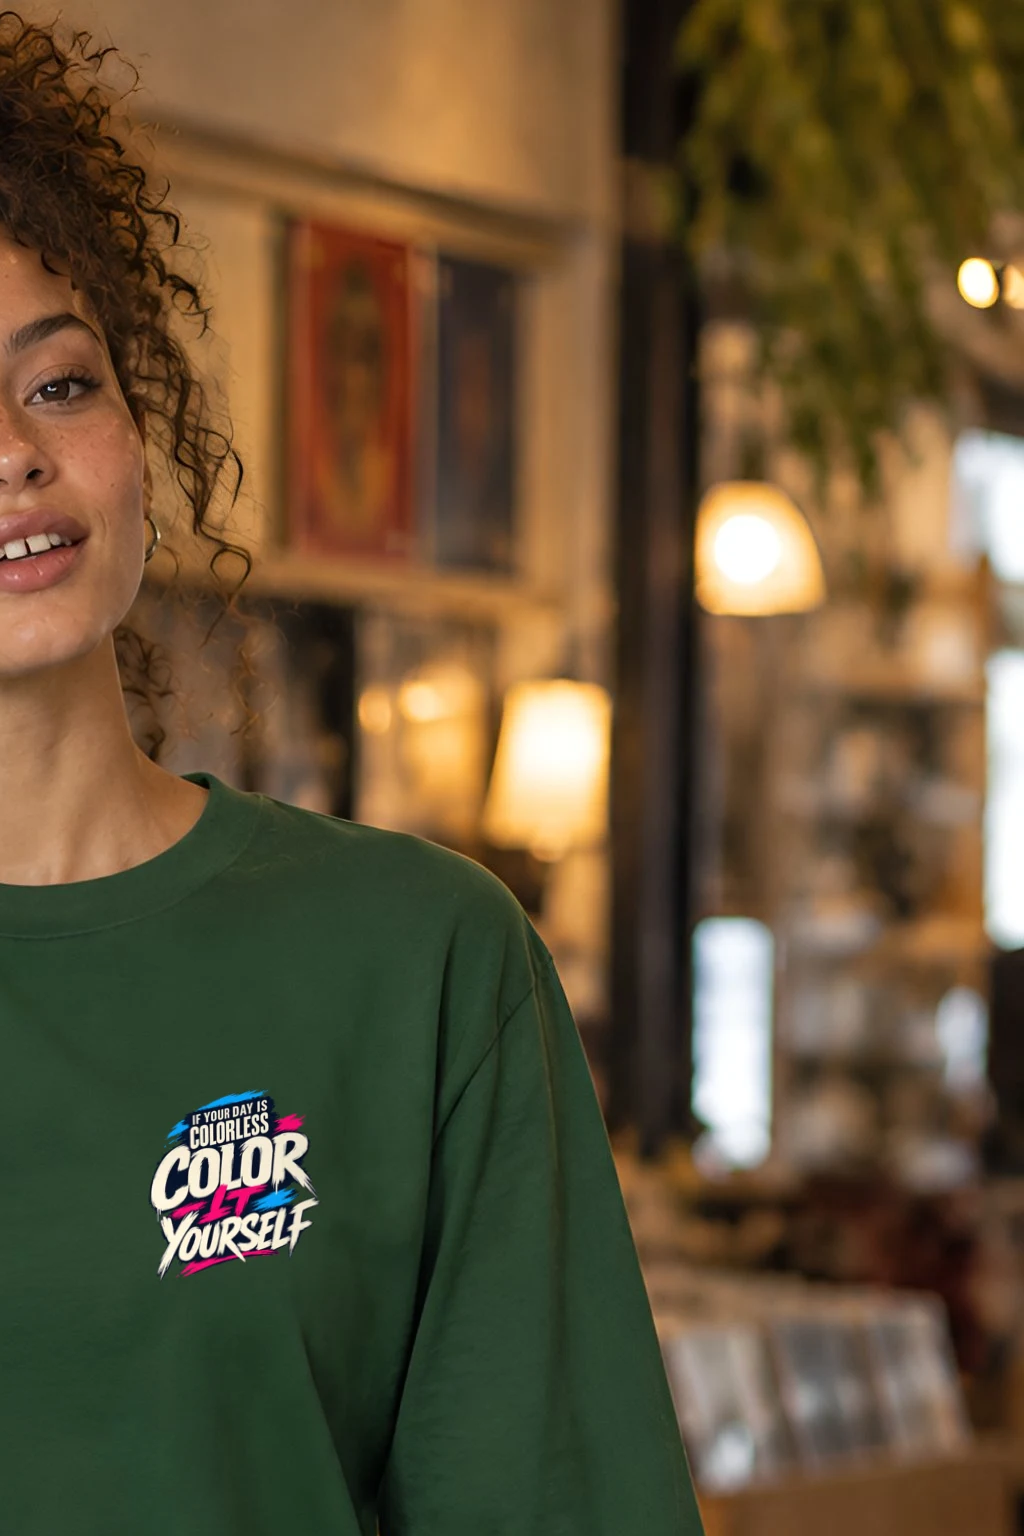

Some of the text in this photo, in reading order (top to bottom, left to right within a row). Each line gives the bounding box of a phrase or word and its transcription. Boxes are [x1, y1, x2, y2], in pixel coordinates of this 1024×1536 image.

[189, 1112, 269, 1149] COLORLESS
[192, 1099, 268, 1125] IF YOUR DAY IS
[151, 1131, 318, 1213] COLOR
[198, 1184, 267, 1224] IT
[157, 1198, 319, 1280] YOURSELF
